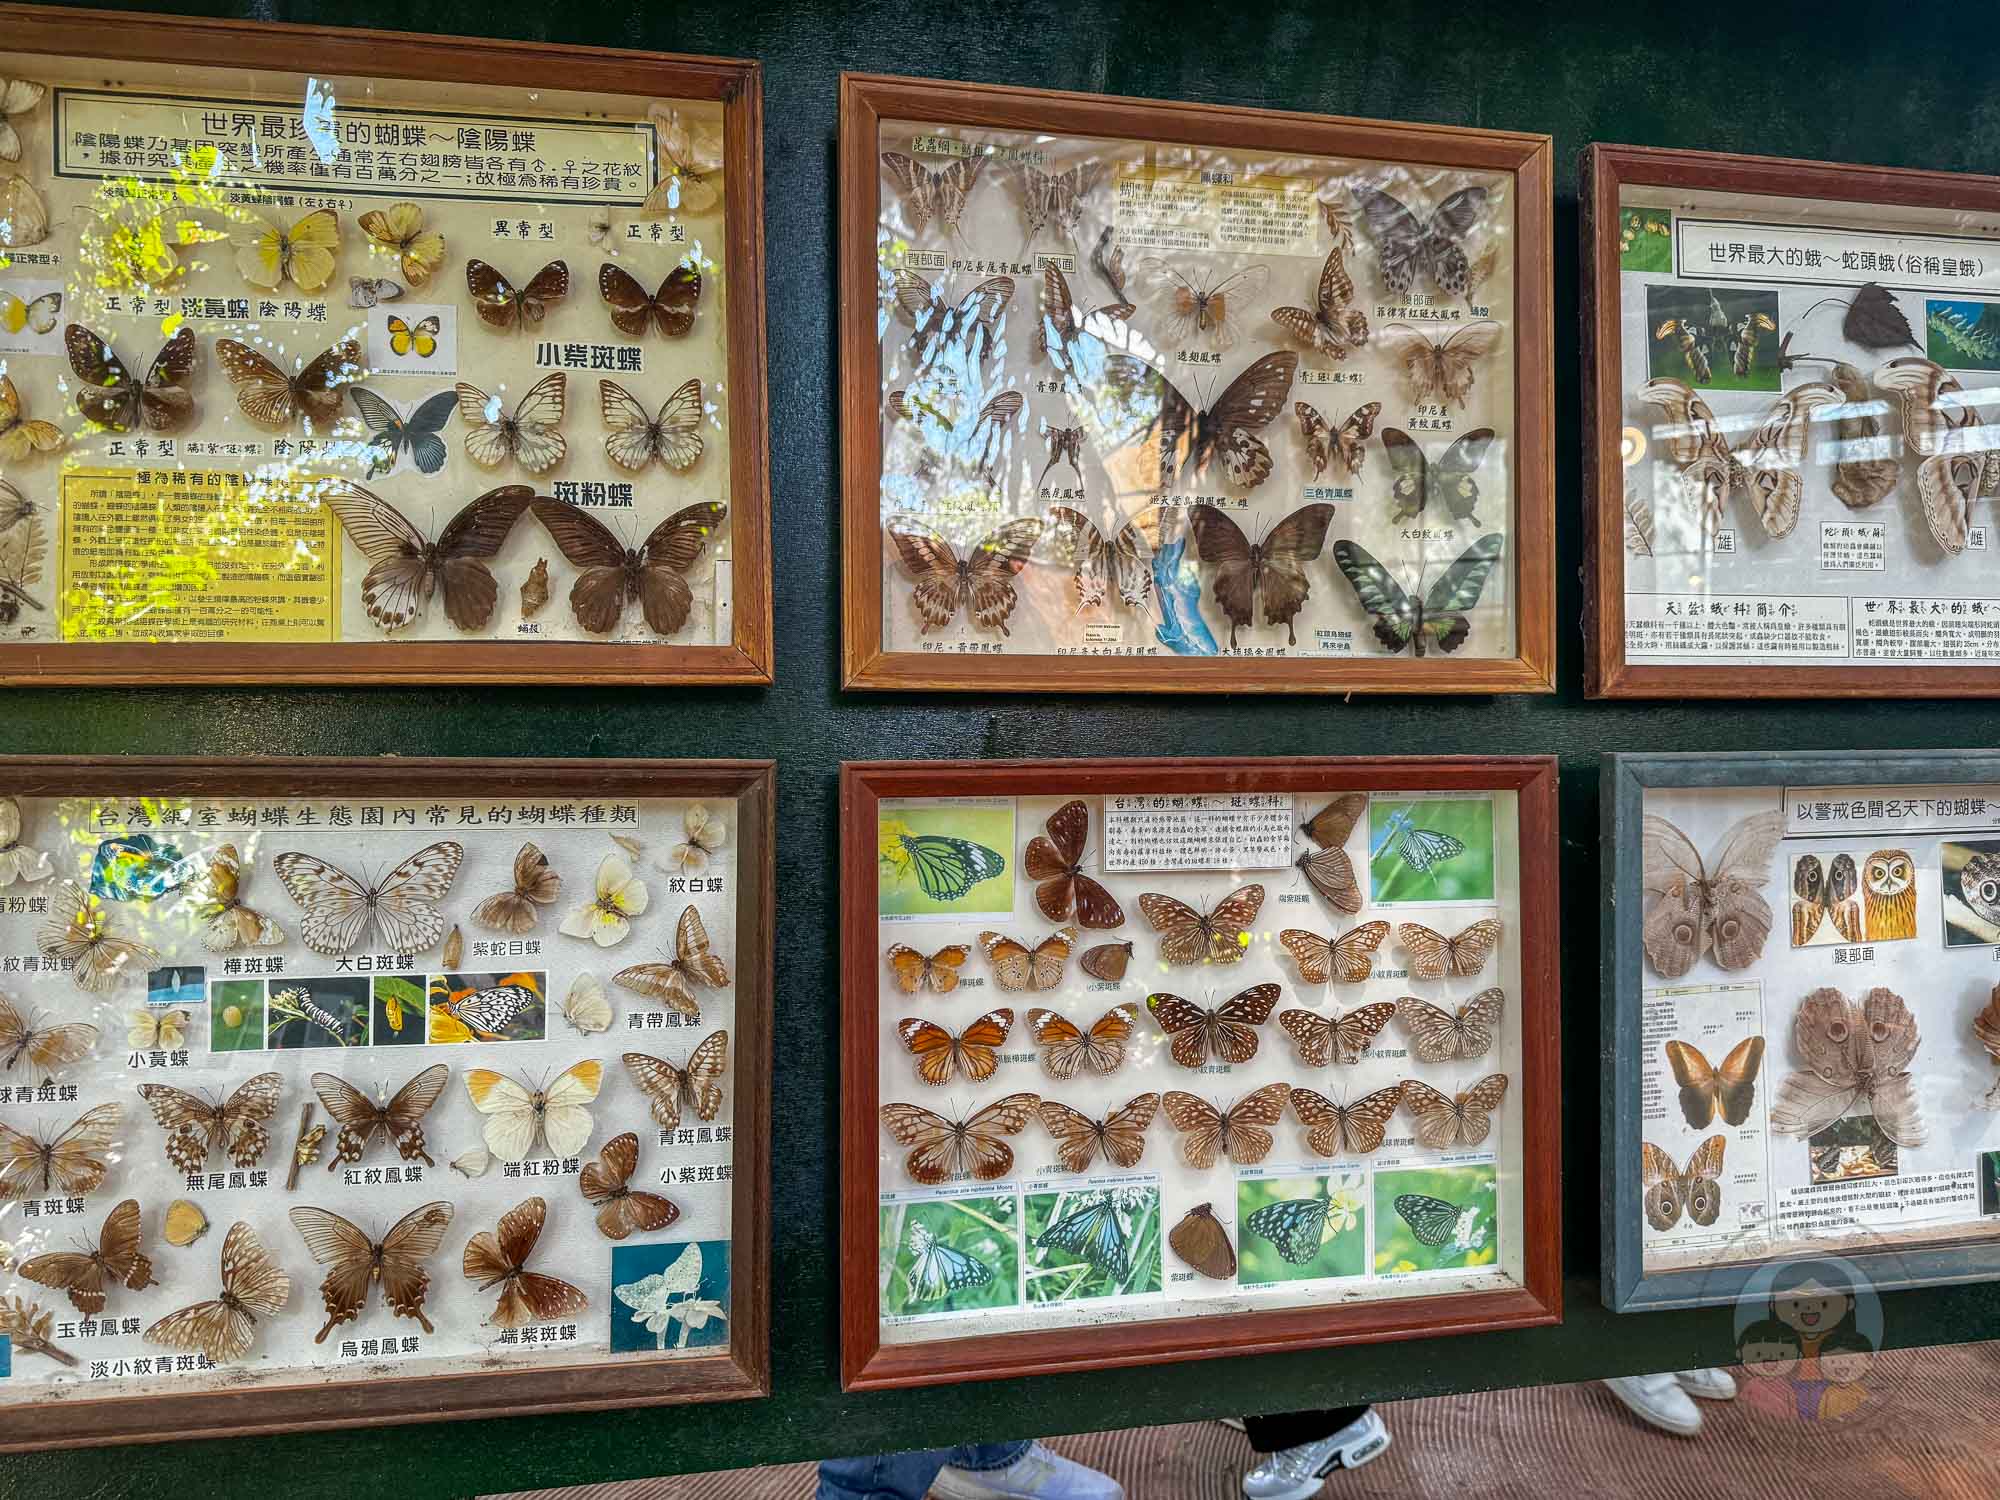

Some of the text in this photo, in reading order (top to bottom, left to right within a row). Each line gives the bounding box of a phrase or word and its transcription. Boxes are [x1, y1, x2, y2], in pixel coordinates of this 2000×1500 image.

[494, 220, 554, 240] 異常型
[626, 224, 685, 242] 正常型
[105, 296, 327, 321] 正常型 淡黃蝶 陰陽蝶
[536, 342, 642, 371] 小紫斑蝶
[109, 440, 174, 458] 正常型
[274, 438, 338, 460] 陰陽
[553, 481, 633, 507] 斑粉蝶
[668, 877, 724, 893] 紋白蝶
[473, 940, 542, 957] 紫蛇目蝶
[1834, 947, 1875, 963] 腹部面
[0, 955, 77, 974] 紋青斑蝶
[223, 956, 285, 975] 樺斑蝶
[335, 955, 415, 973] 大白斑蝶
[627, 1012, 702, 1030] 青帶鳳蝶
[128, 1050, 190, 1068] 小黃蝶
[659, 1125, 733, 1146] 青斑鳳蝶
[344, 1165, 424, 1186] 紅紋鳳蝶
[503, 1158, 581, 1179] 端紅粉蝶
[660, 1164, 733, 1184] 小紫斑蝶
[186, 1173, 269, 1192] 無尾鳳蝶
[22, 1198, 85, 1217] 青斑蝶
[56, 1317, 141, 1339] 玉帶鳳蝶
[501, 1325, 577, 1344] 端紫斑蝶
[341, 1336, 420, 1358] 烏鴉鳳蝶
[90, 1353, 216, 1378] 淡小紋青斑蝶
